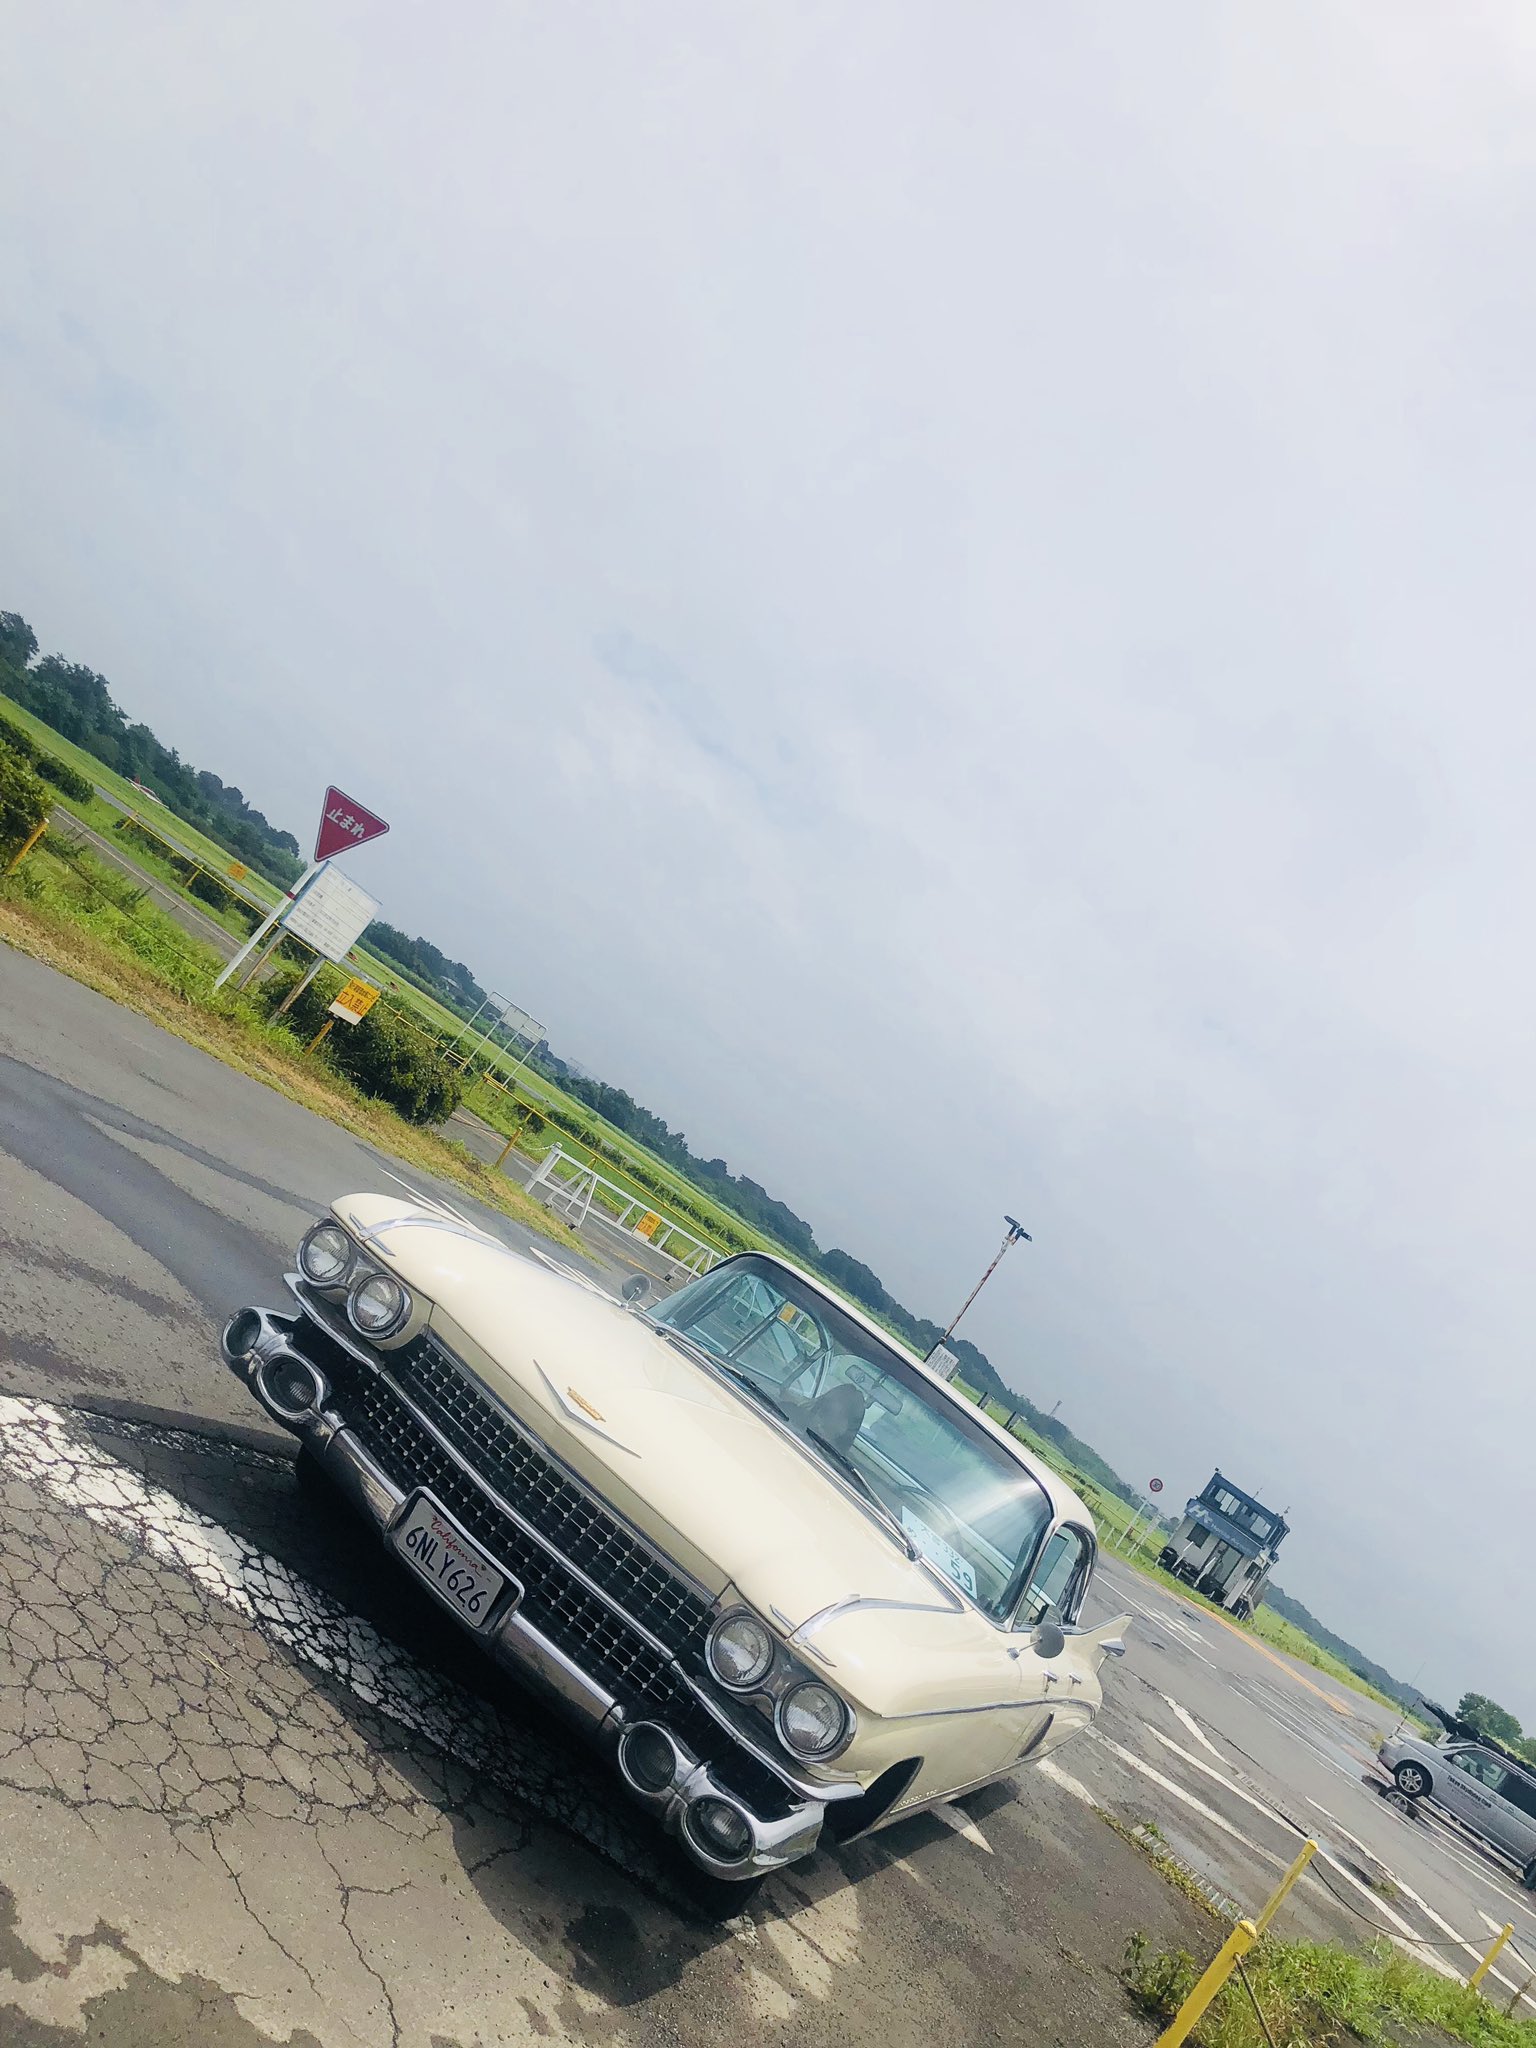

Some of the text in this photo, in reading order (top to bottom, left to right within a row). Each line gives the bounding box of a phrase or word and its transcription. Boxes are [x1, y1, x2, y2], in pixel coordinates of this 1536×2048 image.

[326, 807, 365, 839] 止まれ
[337, 989, 369, 1017] 立入禁止
[431, 1520, 482, 1577] California
[406, 1526, 487, 1613] 6NLY626
[950, 1559, 973, 1592] 59
